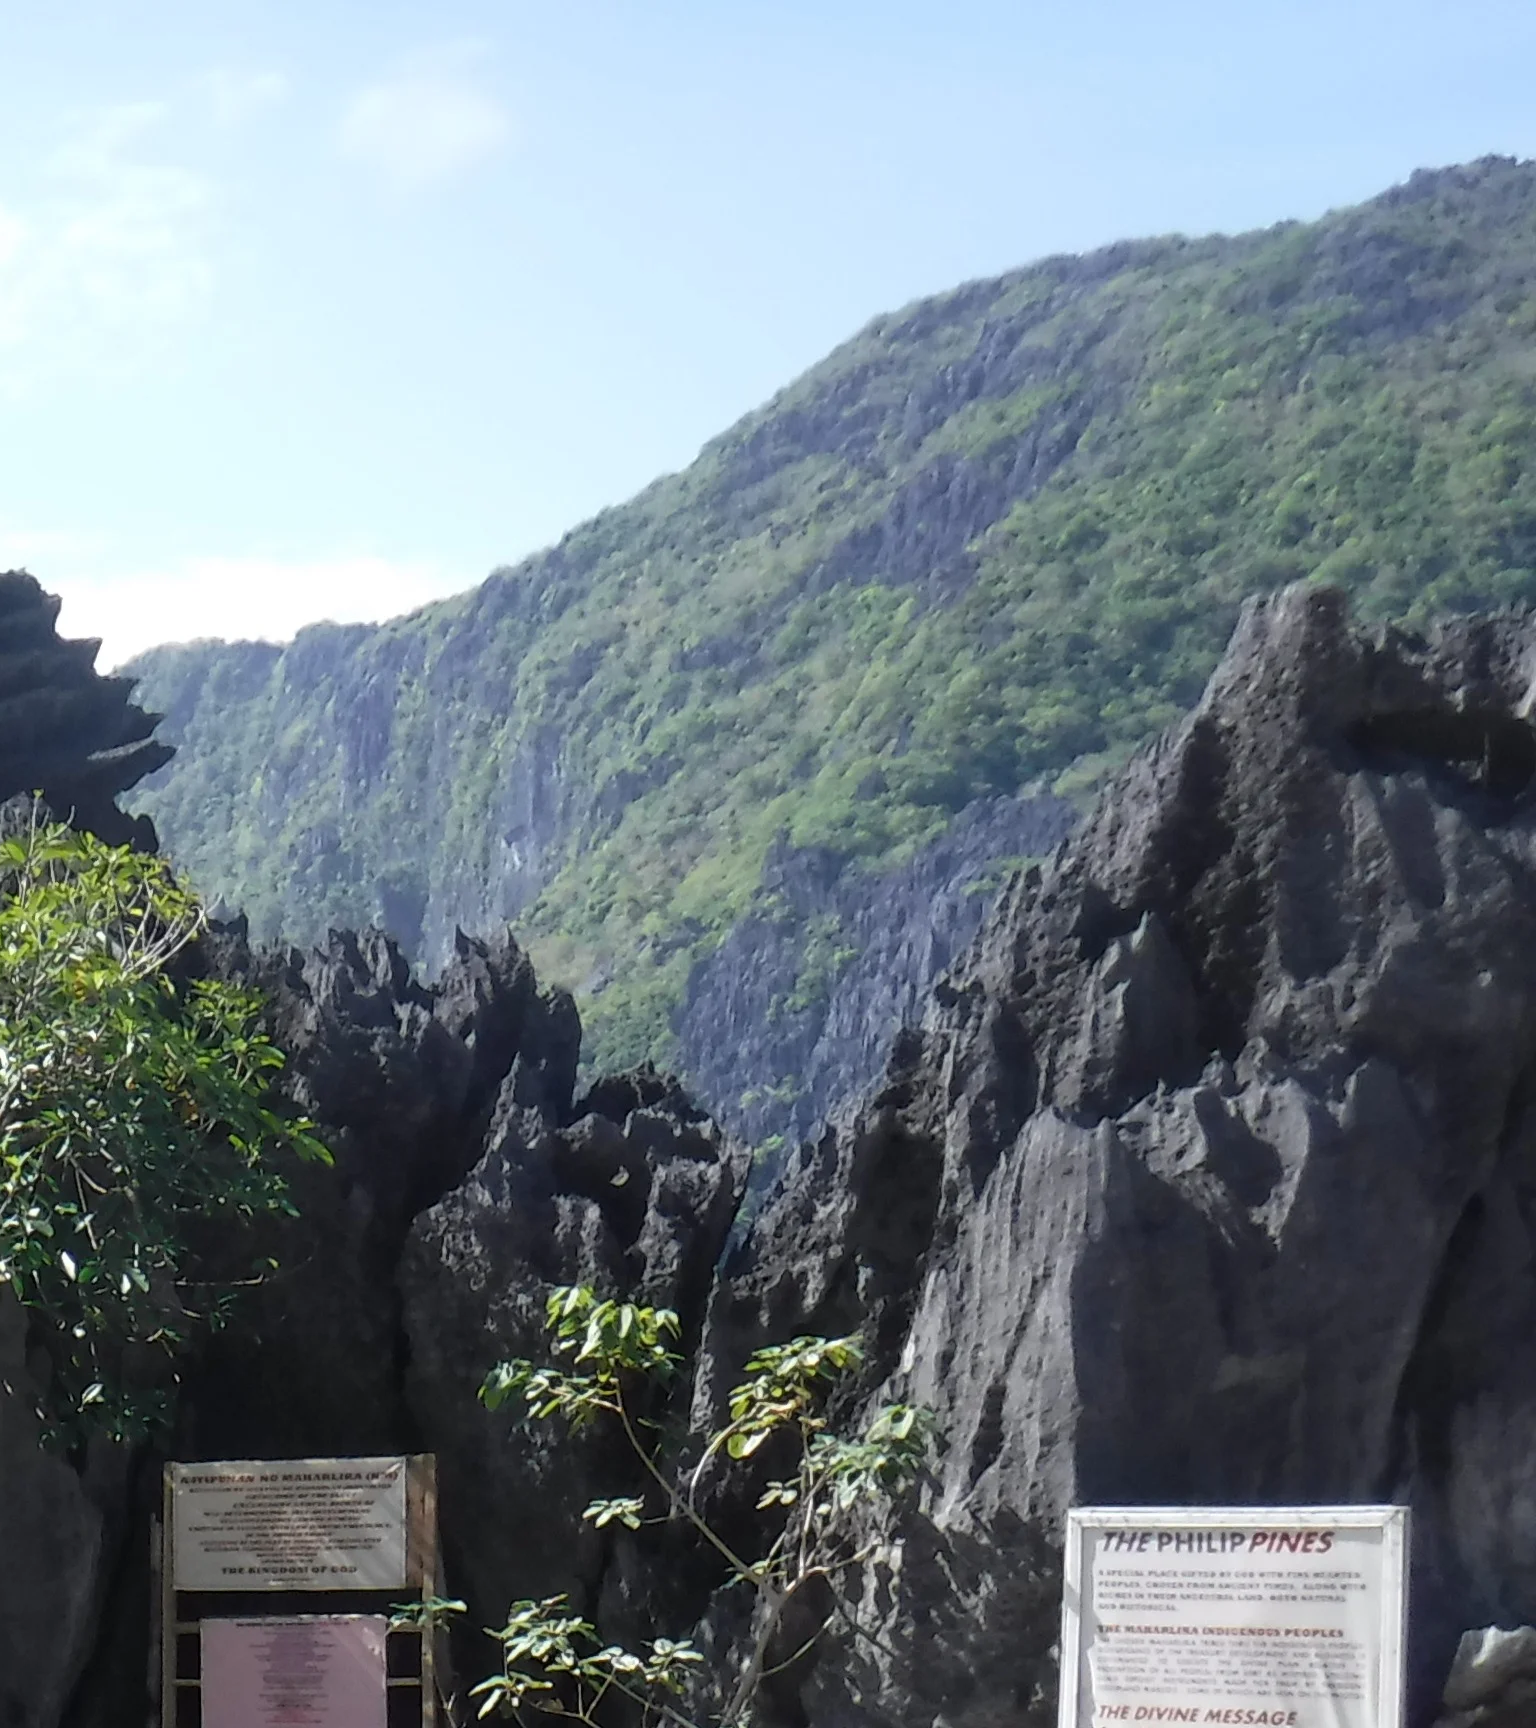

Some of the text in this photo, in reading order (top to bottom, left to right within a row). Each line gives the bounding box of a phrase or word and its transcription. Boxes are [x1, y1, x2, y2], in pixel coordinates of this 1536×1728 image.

[1103, 1530, 1152, 1553] THE
[1099, 1705, 1298, 1727] THE DIVINE MESSAGE
